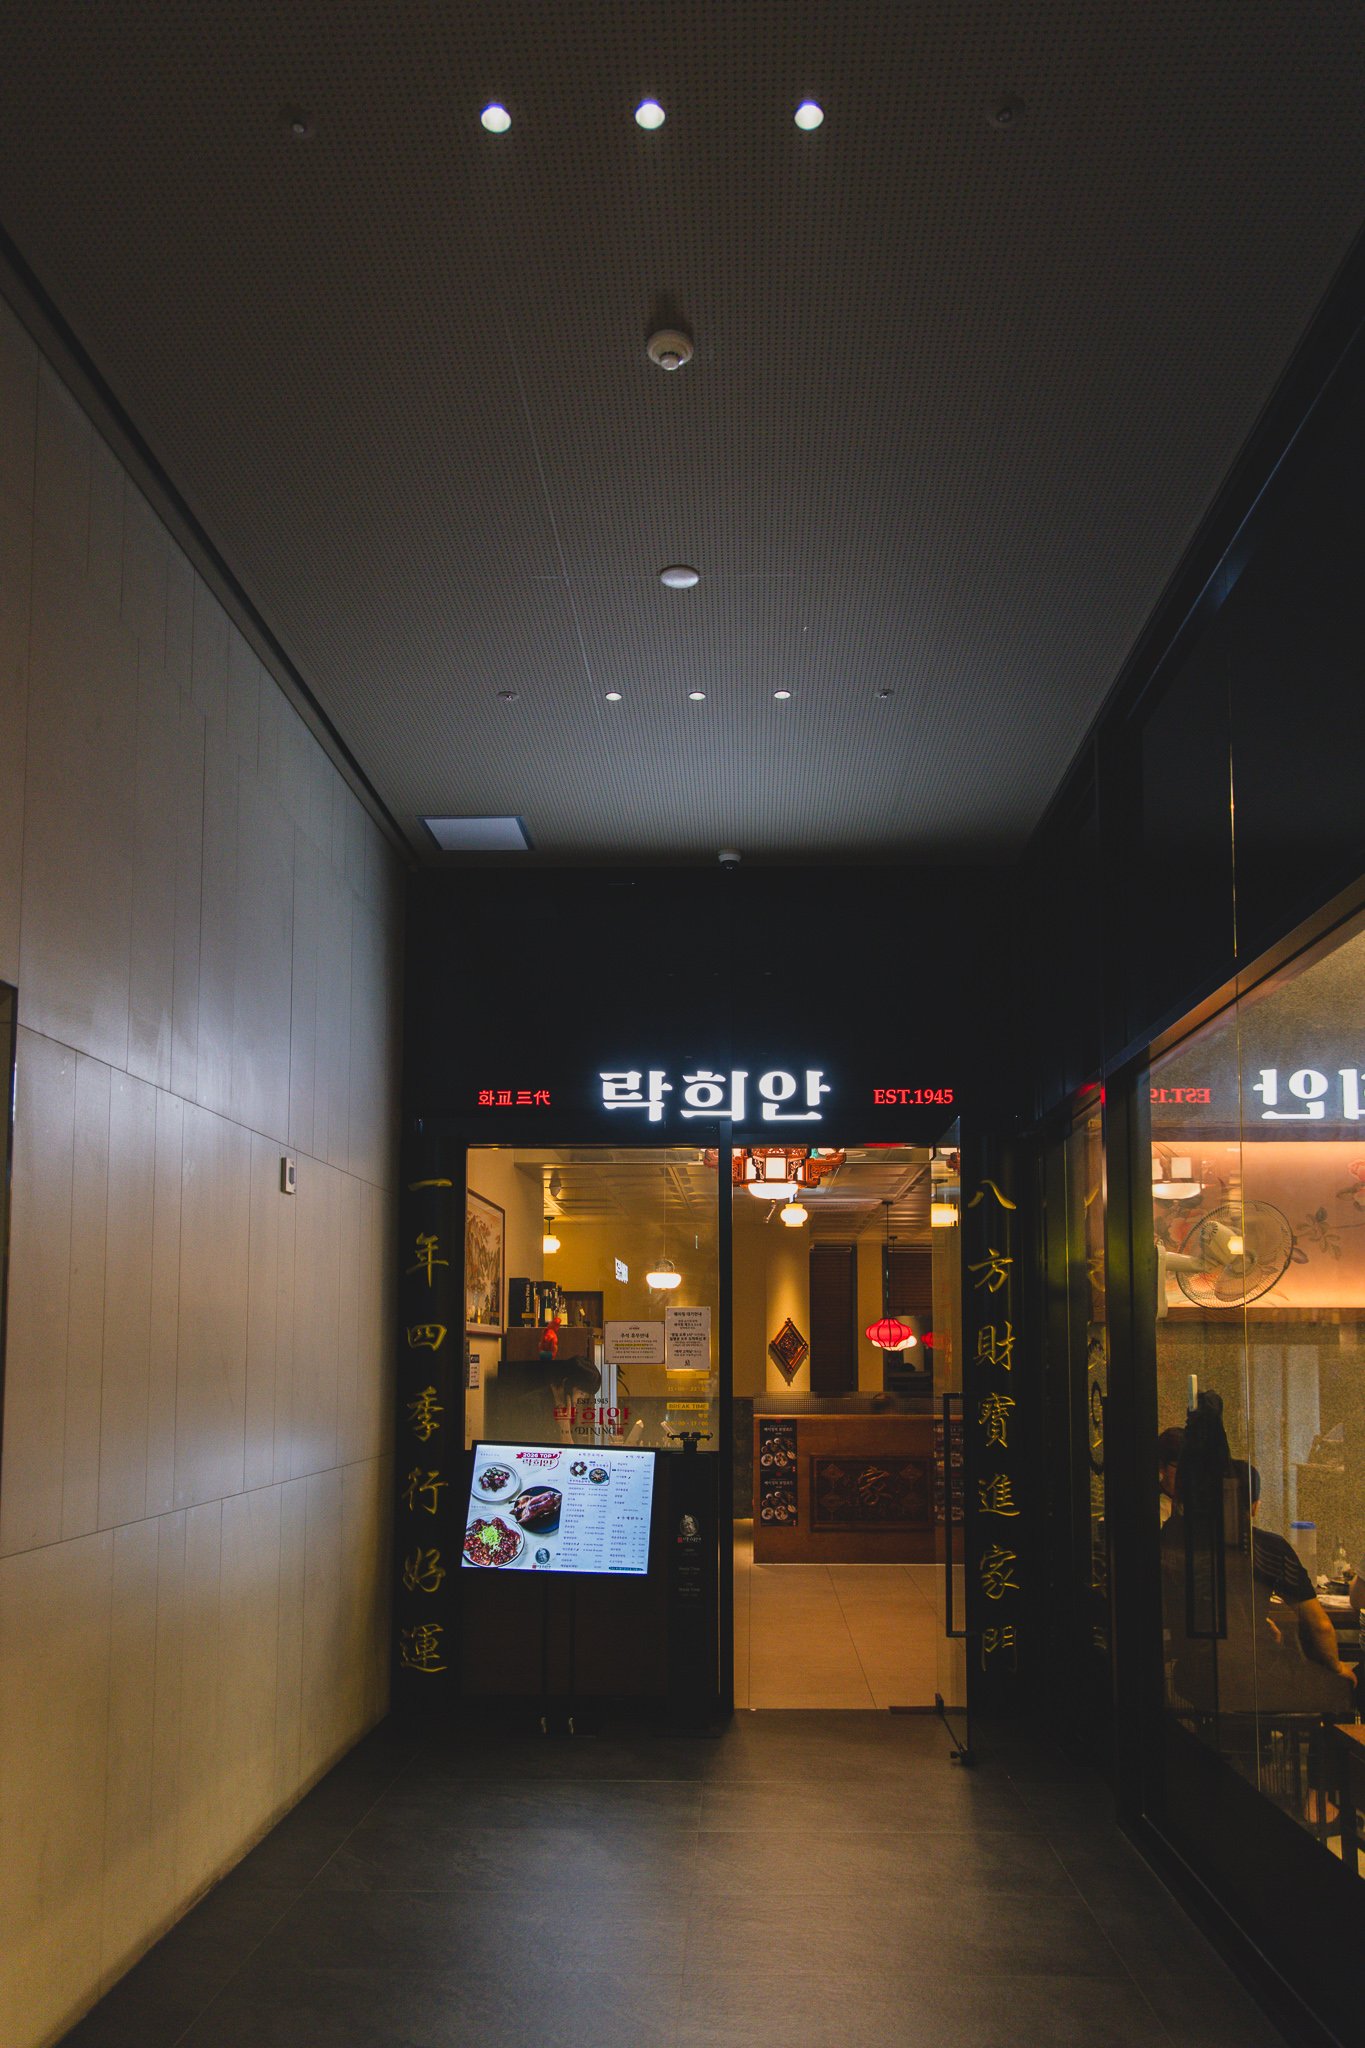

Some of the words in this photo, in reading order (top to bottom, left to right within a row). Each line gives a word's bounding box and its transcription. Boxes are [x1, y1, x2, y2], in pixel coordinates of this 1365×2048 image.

[478, 1090, 513, 1106] 화교
[516, 1090, 551, 1105] 三代
[599, 1069, 831, 1122] 락희안
[873, 1088, 954, 1104] EST.1945
